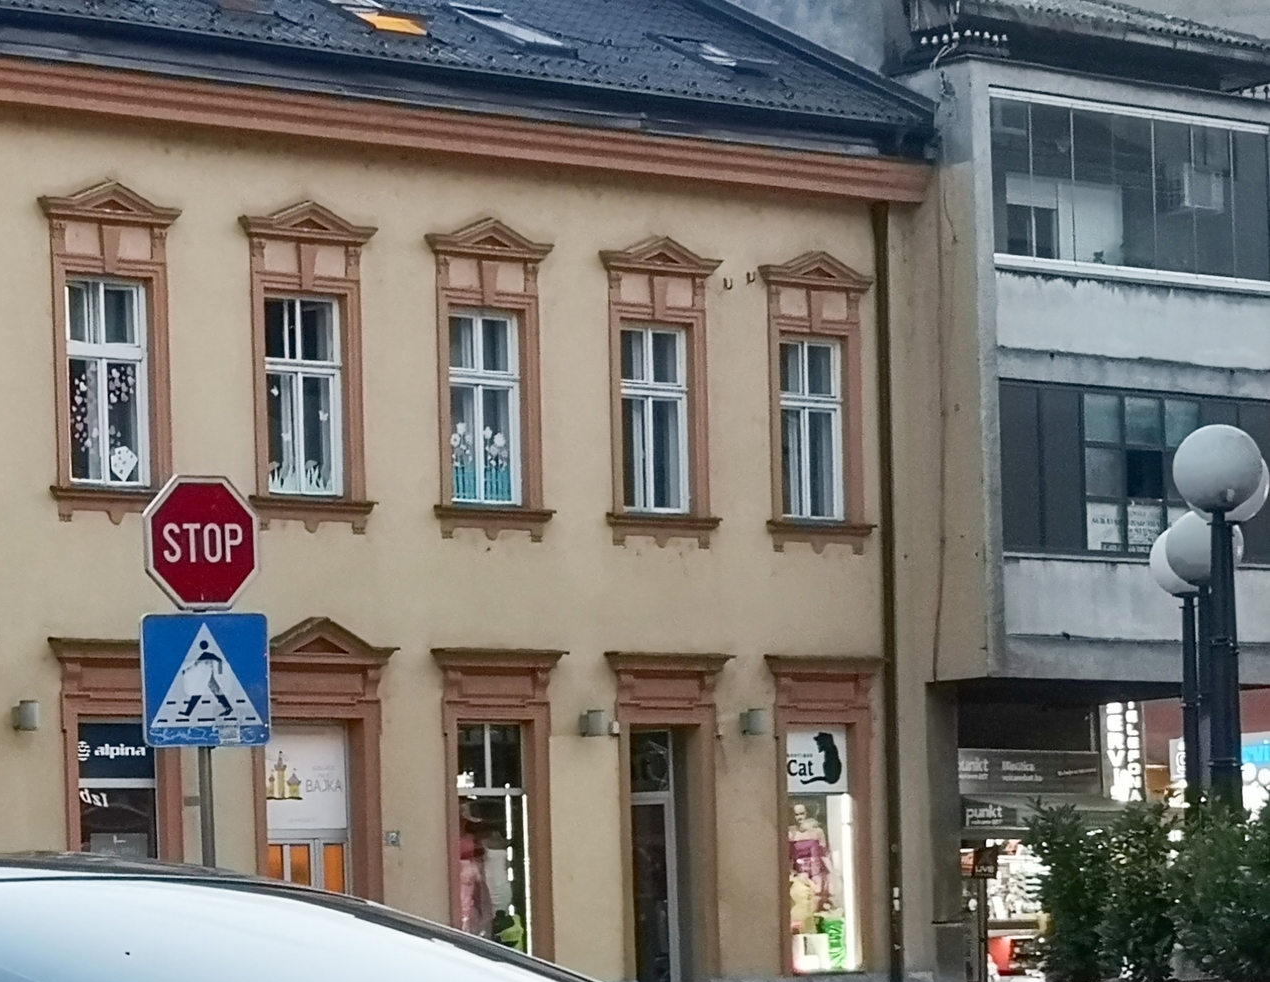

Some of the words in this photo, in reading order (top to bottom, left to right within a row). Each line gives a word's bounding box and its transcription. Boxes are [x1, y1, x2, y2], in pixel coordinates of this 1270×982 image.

[162, 522, 243, 563] STOP
[94, 743, 147, 759] alpina
[786, 759, 814, 777] Cat
[305, 779, 343, 793] BAJKA
[965, 804, 1004, 827] punkt
